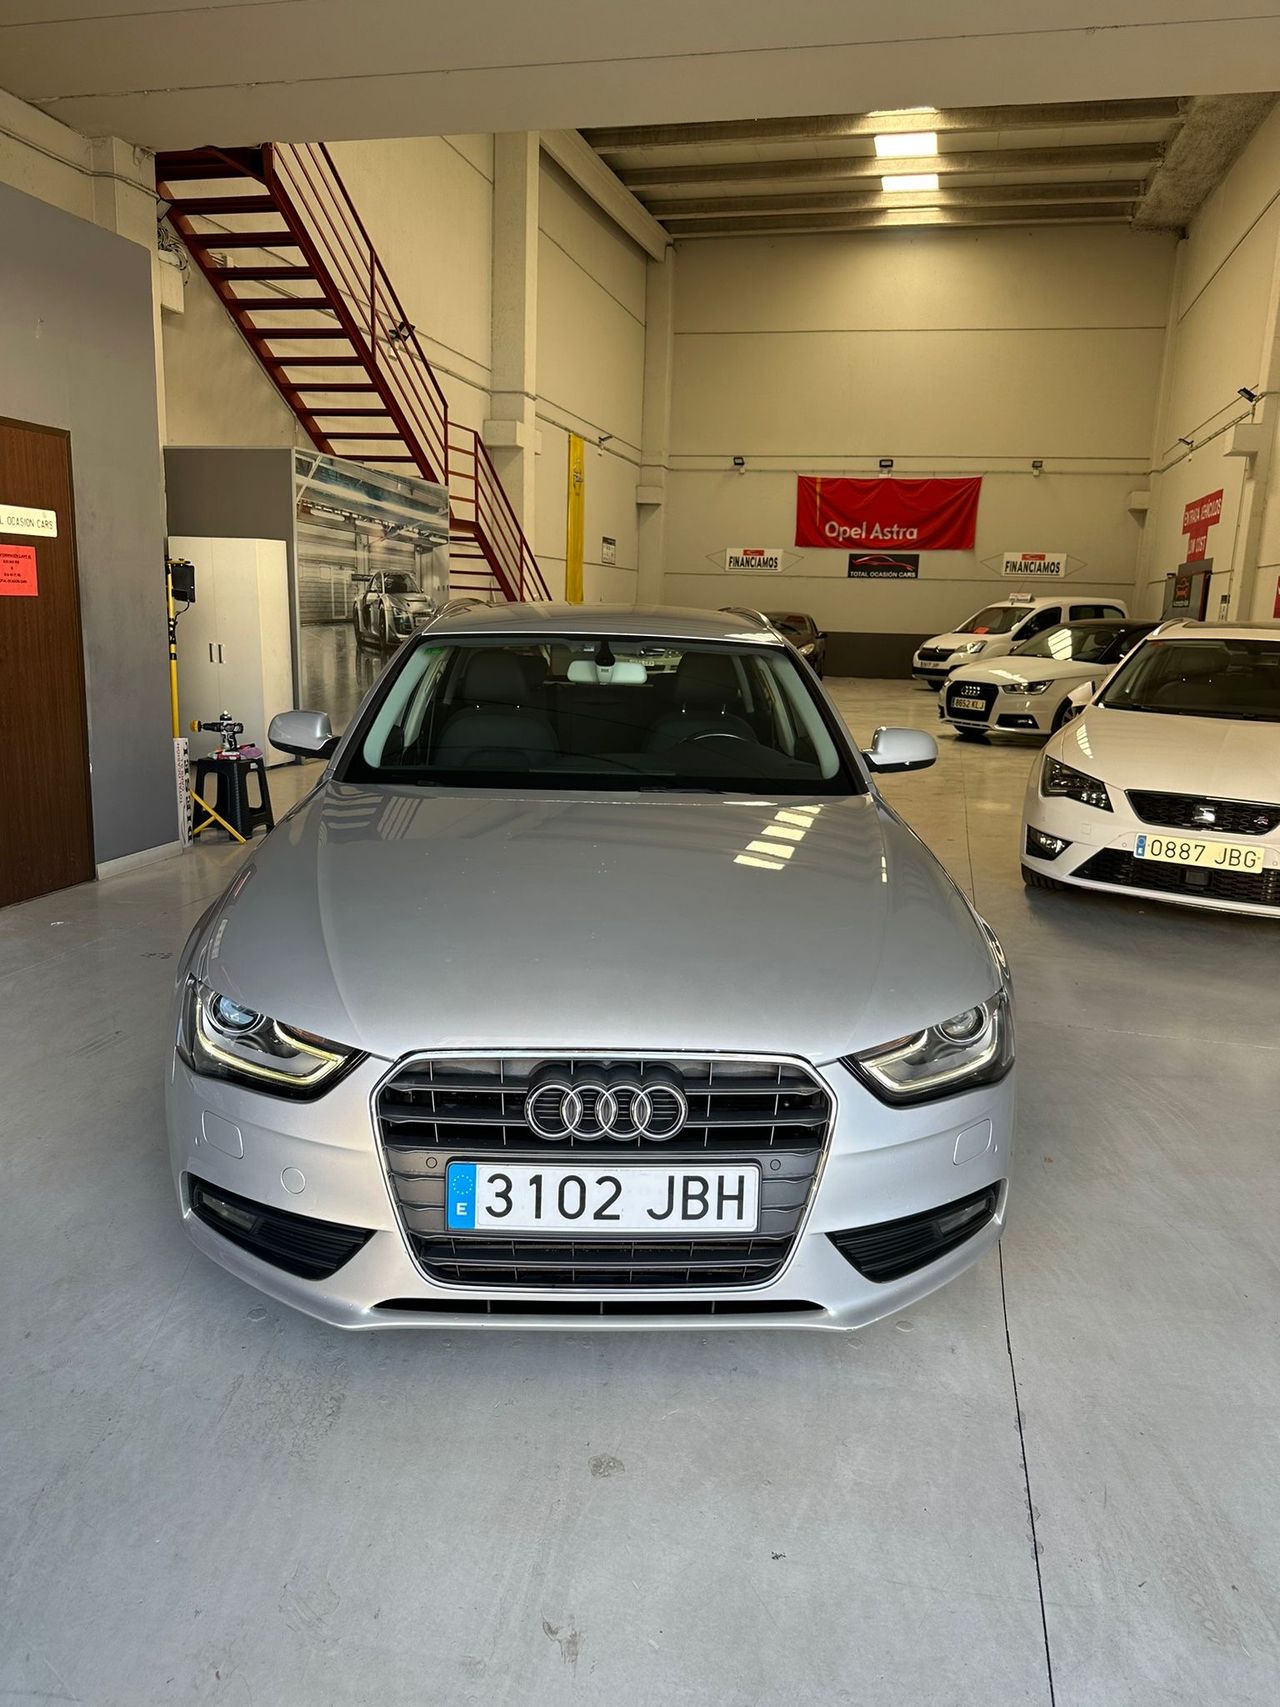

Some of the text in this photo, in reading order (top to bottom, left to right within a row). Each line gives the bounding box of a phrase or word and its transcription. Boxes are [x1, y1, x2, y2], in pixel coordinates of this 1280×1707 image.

[7, 516, 35, 528] OCASION
[37, 519, 54, 530] CARS
[825, 521, 918, 541] Opel Astra
[728, 556, 778, 568] FINANCIAMOS
[1004, 561, 1061, 573] FINANCIAMOS
[869, 570, 898, 578] OCASIÓN
[1151, 839, 1257, 868] 0887 JBG
[485, 1173, 745, 1221] 3102 JBH
[456, 1203, 467, 1215] E
